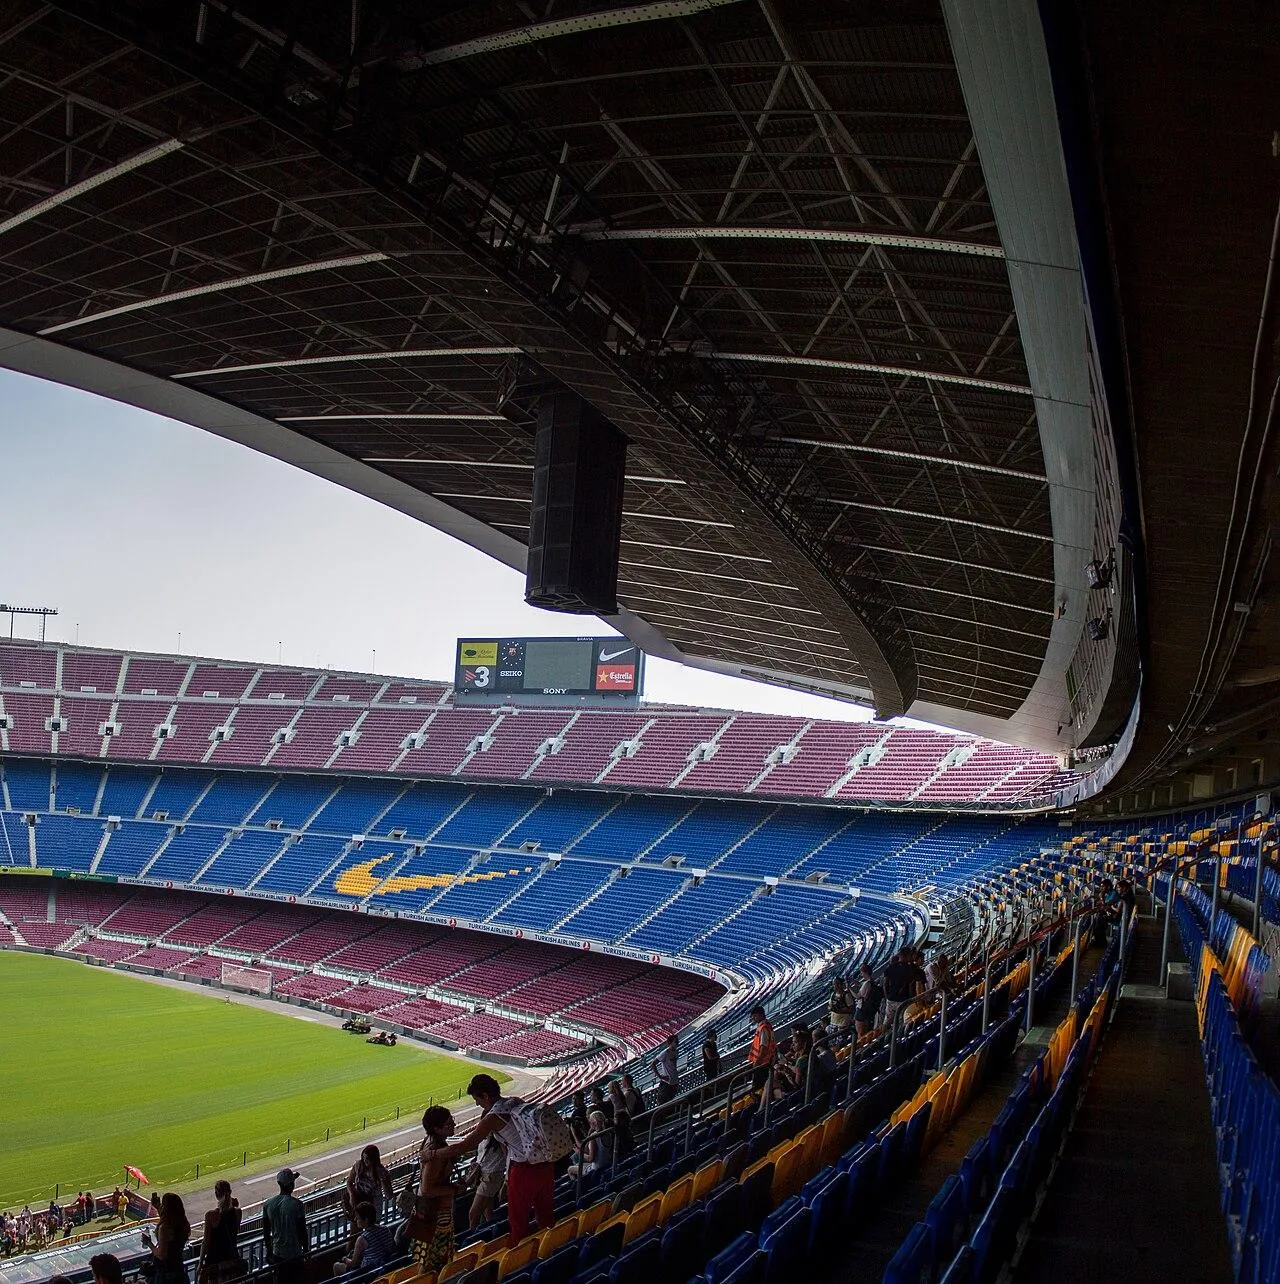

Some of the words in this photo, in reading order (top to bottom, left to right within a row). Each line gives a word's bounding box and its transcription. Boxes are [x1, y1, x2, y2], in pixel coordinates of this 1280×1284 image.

[474, 666, 490, 687] 3
[609, 671, 633, 680] Estrella
[204, 886, 225, 894] AIRLINES
[244, 891, 265, 899] TURKISH
[265, 893, 287, 901] AIRLINES
[307, 899, 328, 907] TURKISH
[328, 902, 350, 910] AIRLINES
[403, 912, 424, 921] TURKISH
[425, 916, 447, 925] AIRLINES
[468, 922, 490, 931] TURKISH
[490, 926, 513, 936] AIRLINES
[535, 934, 557, 943] TURKISH
[557, 937, 581, 948] AIRLINES
[602, 946, 625, 956] TURKISH
[626, 951, 650, 962] AIRLINES
